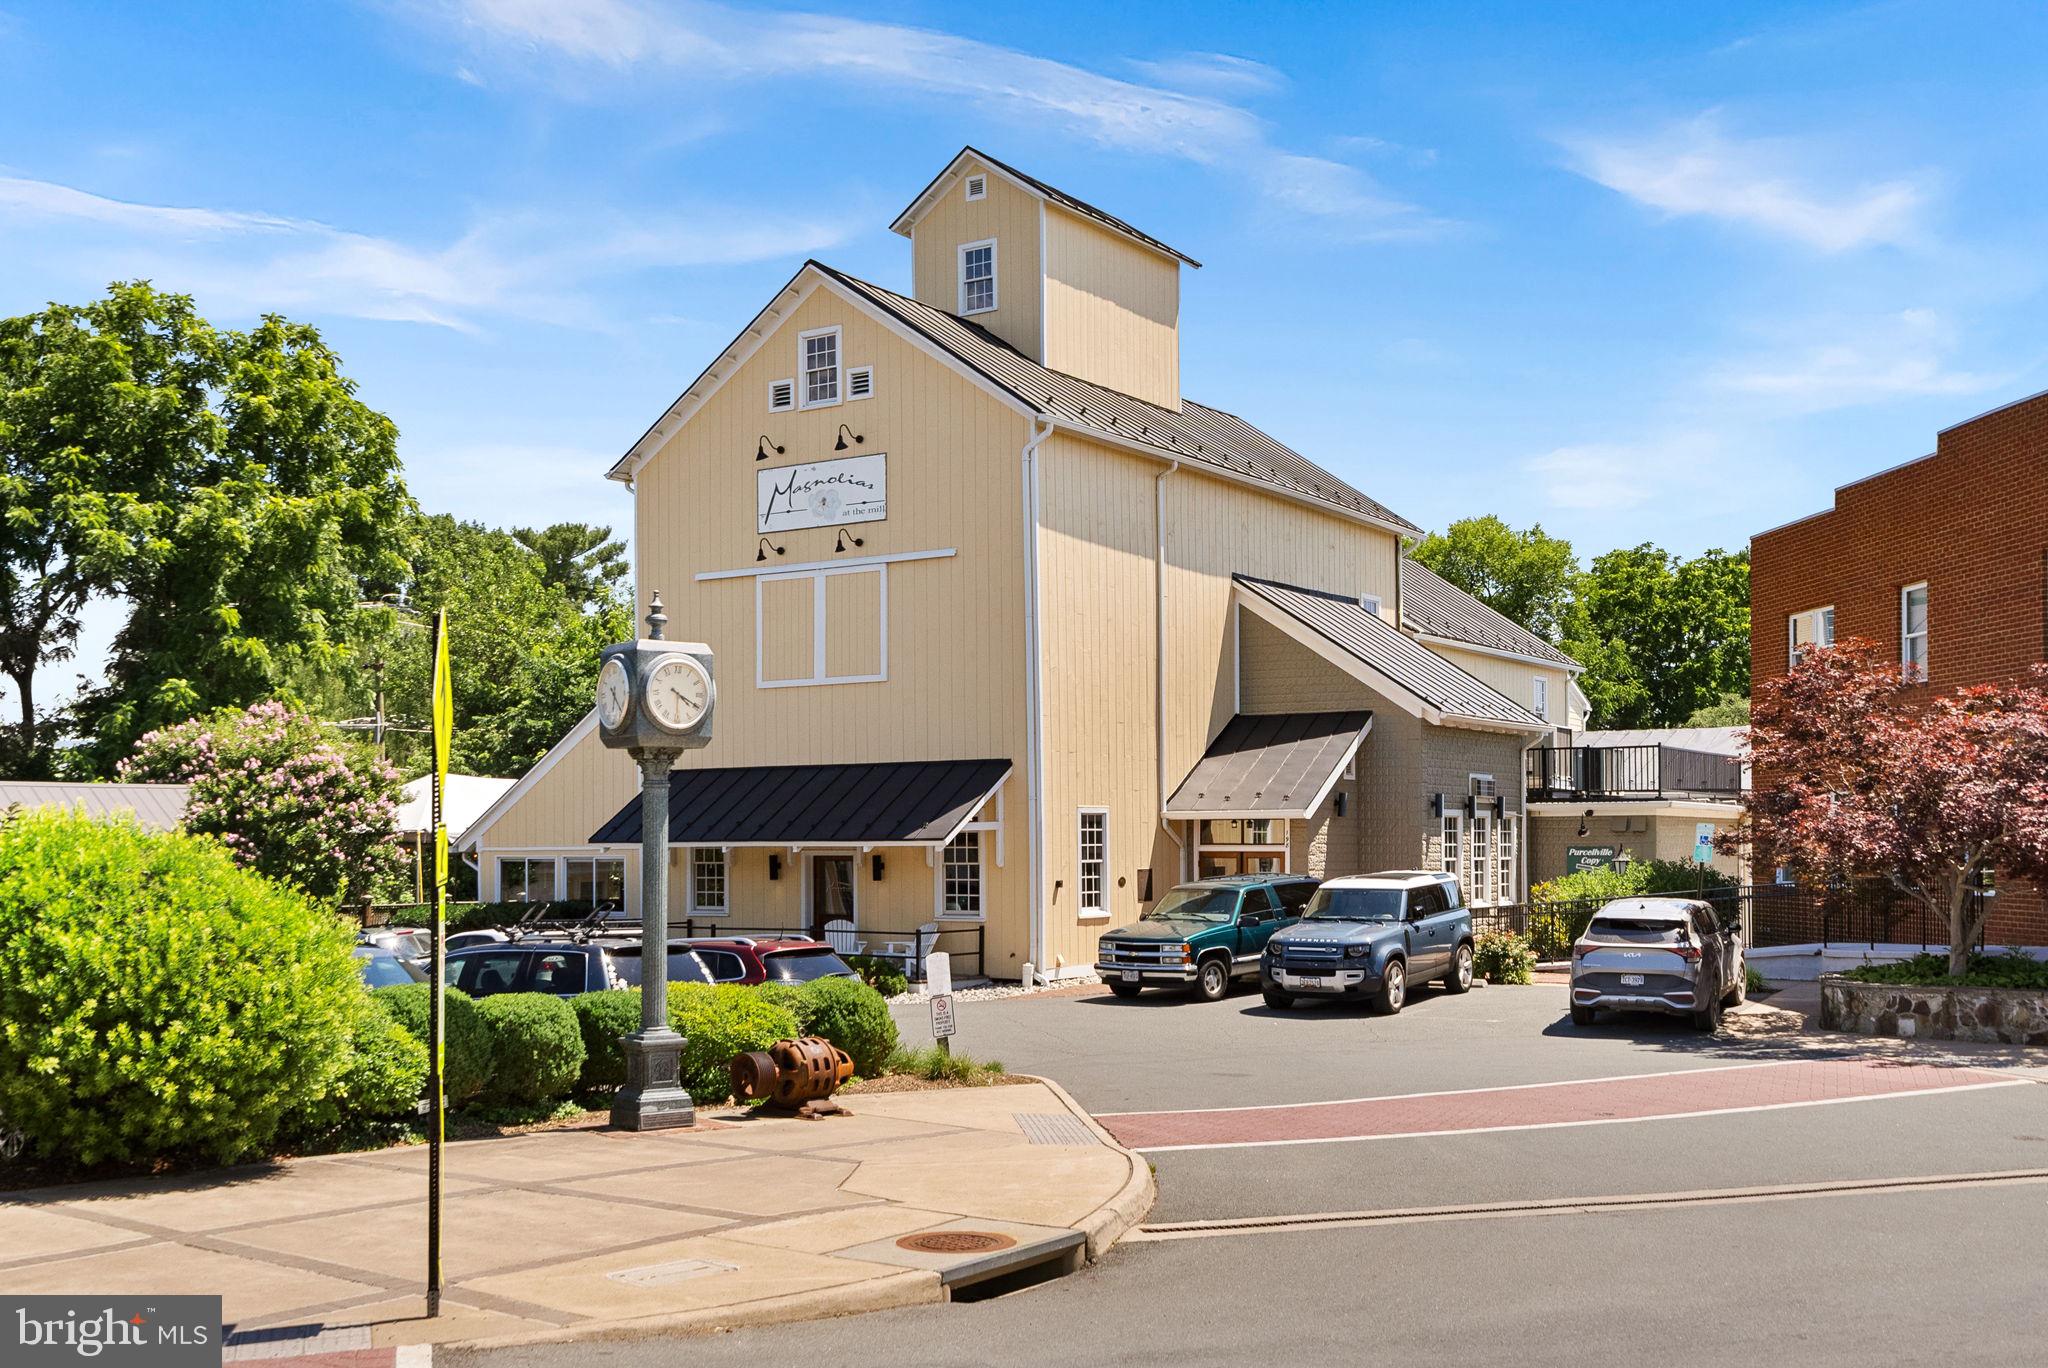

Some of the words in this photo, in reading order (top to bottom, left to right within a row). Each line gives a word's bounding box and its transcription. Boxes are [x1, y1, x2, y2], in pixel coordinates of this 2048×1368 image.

[764, 469, 874, 526] Magnolias
[842, 508, 851, 517] at
[852, 505, 866, 516] the
[868, 504, 886, 514] mill
[1568, 848, 1613, 856] Purcellville
[1580, 856, 1601, 866] Copy
